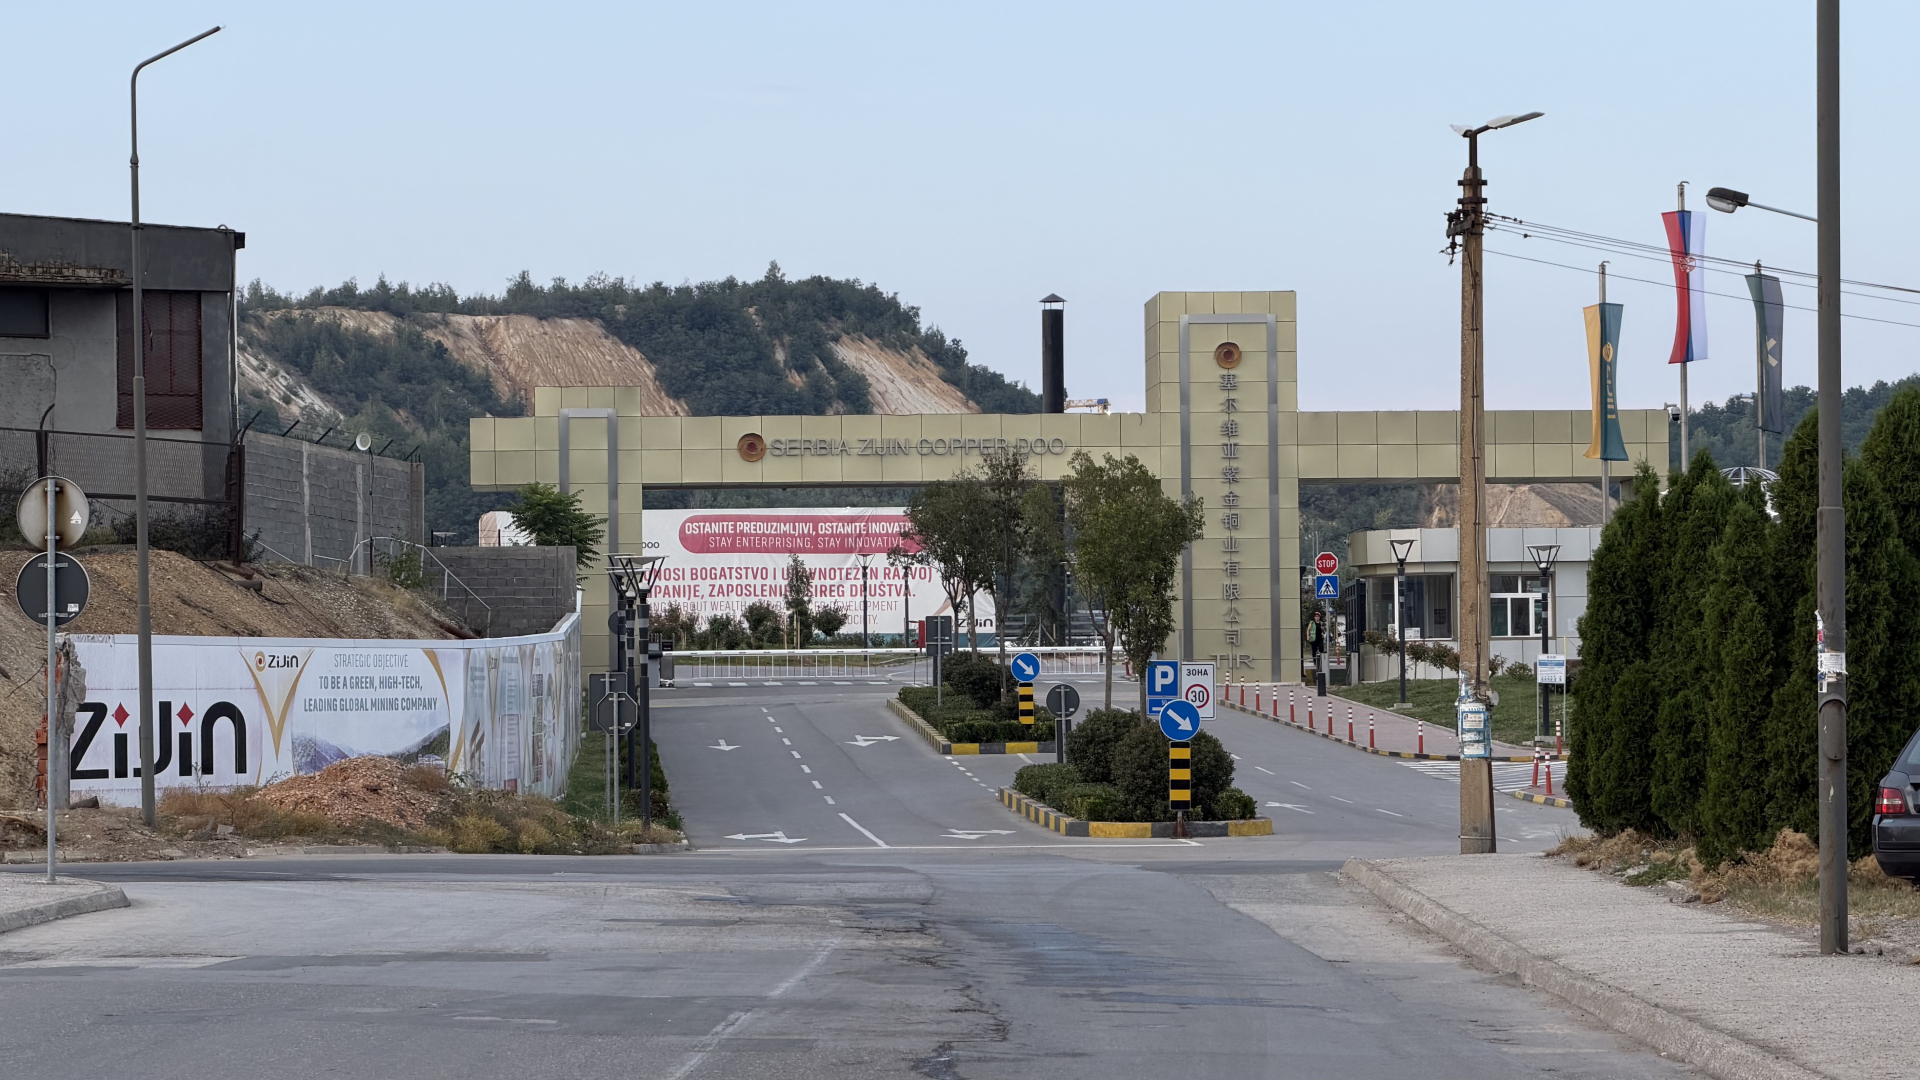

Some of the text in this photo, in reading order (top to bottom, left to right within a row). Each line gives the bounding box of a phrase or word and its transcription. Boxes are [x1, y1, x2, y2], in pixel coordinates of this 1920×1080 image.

[770, 436, 1066, 457] SERBIA ZIJIN COPPER DOO
[1220, 373, 1242, 647] 塞尔维亚紫金铜业有限公司
[685, 522, 735, 535] OSTANITE
[736, 522, 816, 536] PREDUZIMLJIVI,
[818, 521, 867, 535] OSTANITE
[709, 536, 904, 549] STAY ENTERPRISING, STAY INNOVATIVE
[1318, 559, 1336, 568] STOP
[690, 567, 769, 581] BOGATSTVO
[710, 601, 746, 612] WEALTH
[334, 653, 409, 670] STRATEGIC OBJECTIVE
[1210, 653, 1254, 670] TIR
[318, 675, 423, 691] TO BE A GREEN, HIGH-TECH,
[1155, 664, 1175, 692] P
[304, 696, 438, 713] LEADING GLOBAL MINING COMPANY
[1190, 690, 1205, 703] 30
